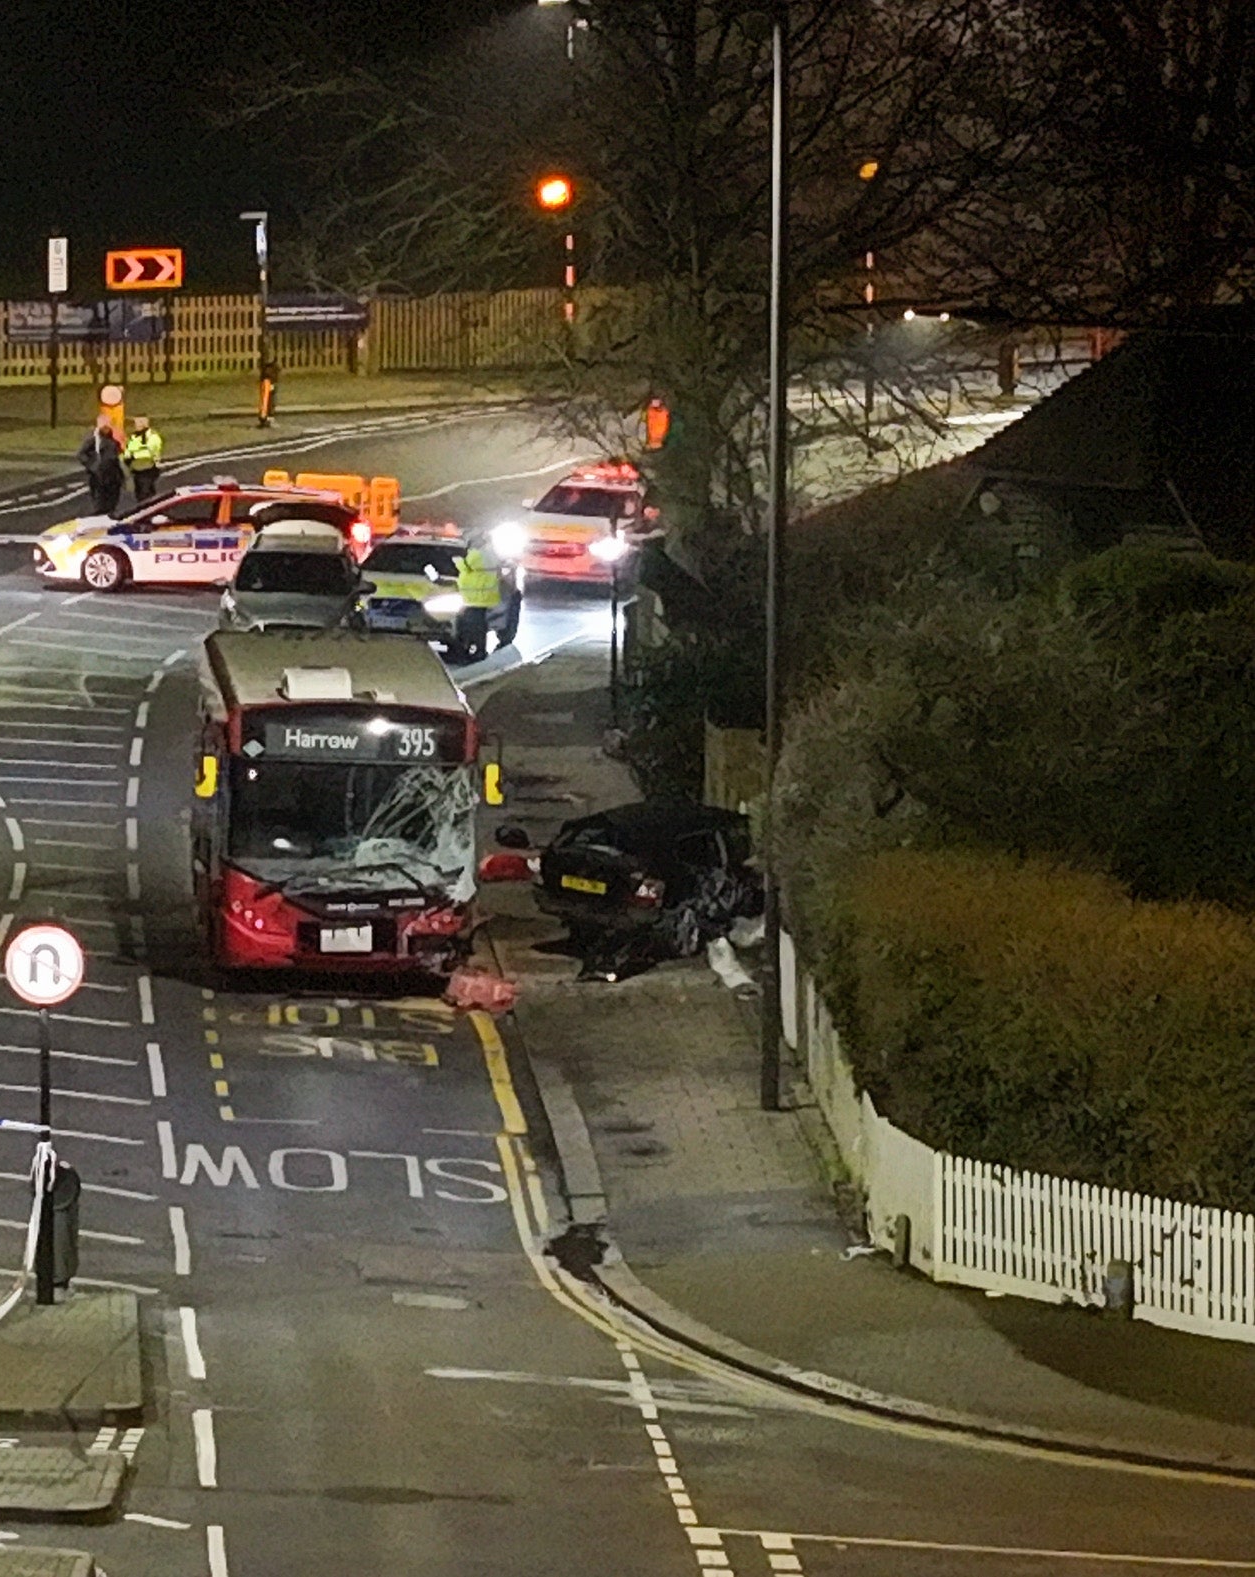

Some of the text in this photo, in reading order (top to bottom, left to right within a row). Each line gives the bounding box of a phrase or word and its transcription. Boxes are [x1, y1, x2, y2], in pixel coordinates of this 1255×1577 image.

[284, 728, 436, 756] Harrow 395
[179, 1143, 509, 1204] SLOW
